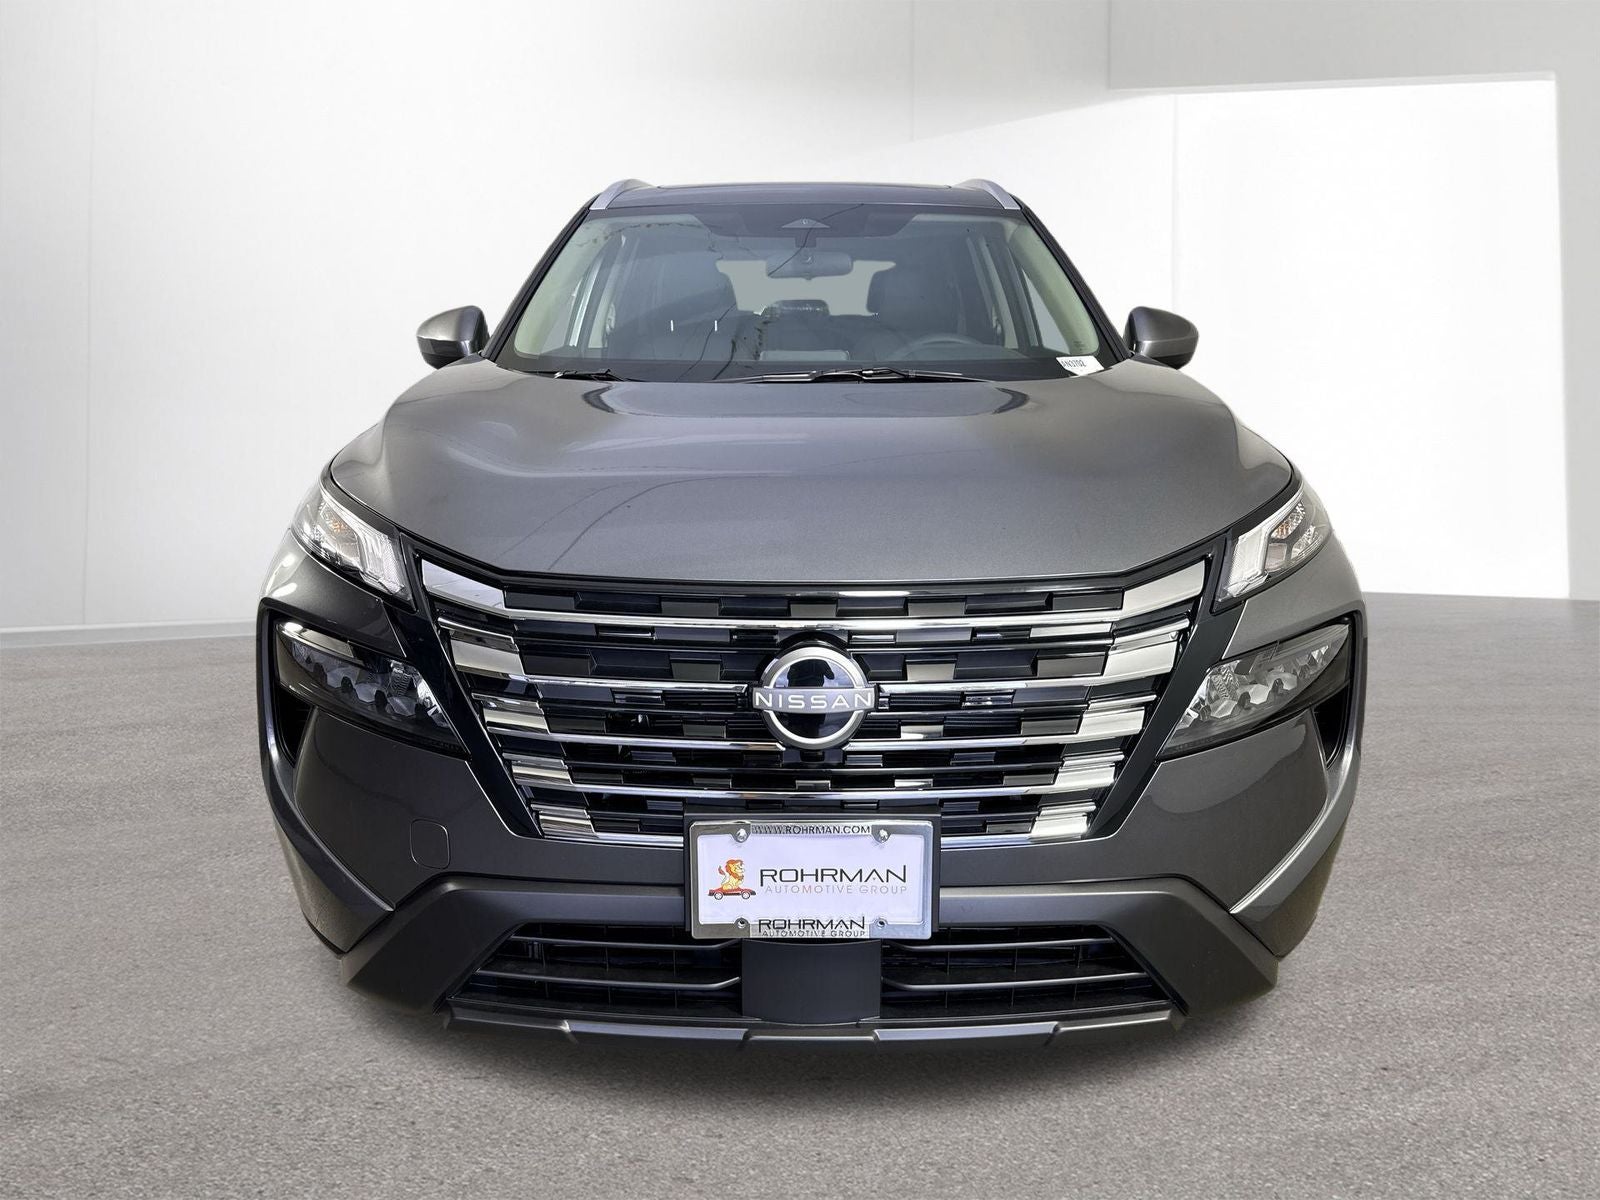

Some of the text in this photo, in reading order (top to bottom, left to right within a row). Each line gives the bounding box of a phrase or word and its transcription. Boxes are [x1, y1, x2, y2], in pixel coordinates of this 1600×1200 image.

[755, 692, 871, 709] NISSAN
[752, 825, 871, 834] WWW.ROHRMAN.COM
[760, 865, 907, 887] ROHRMAN
[765, 885, 907, 895] AUTOMOTIVE GROUP
[758, 916, 865, 933] ROHRMAN
[761, 929, 866, 938] AUTOMOTIVE GROUP
